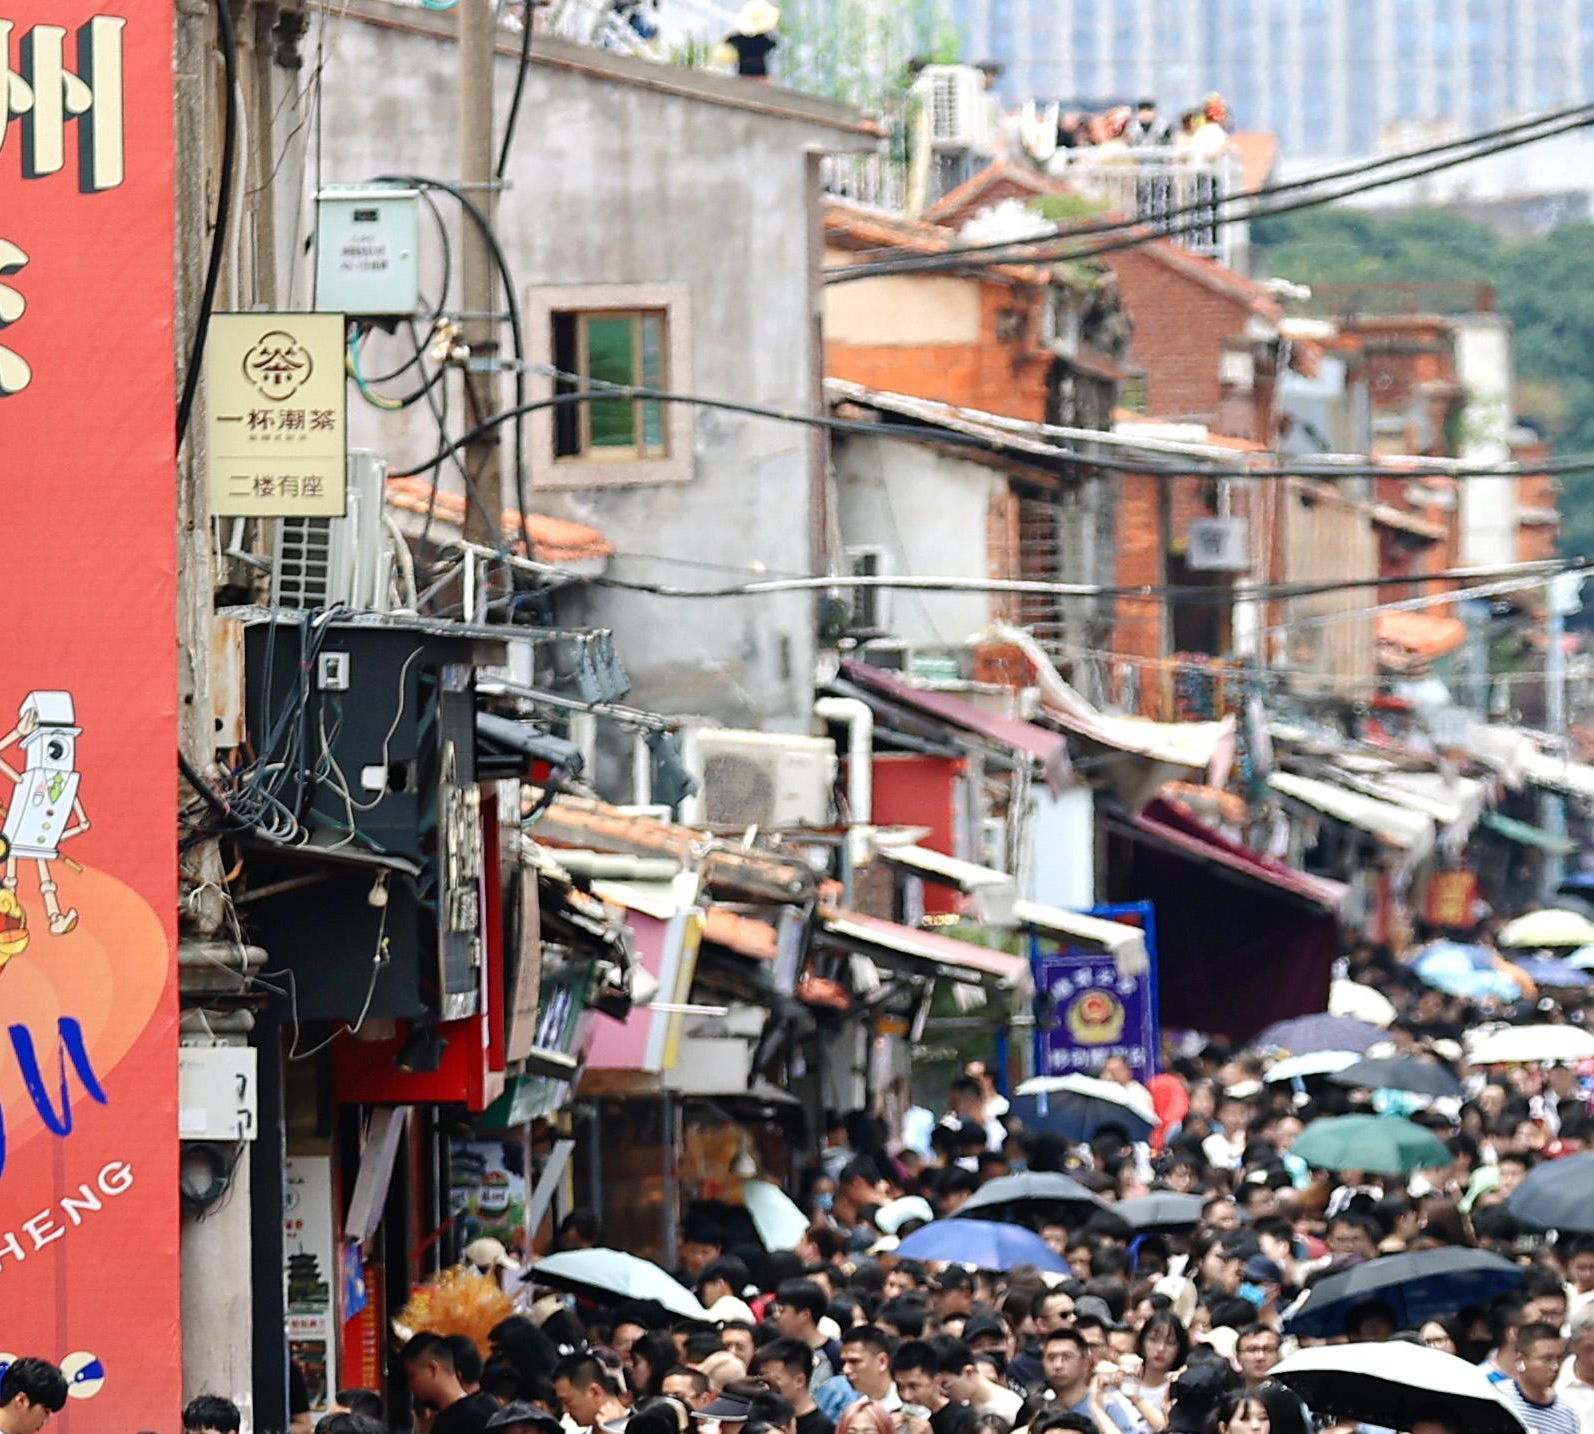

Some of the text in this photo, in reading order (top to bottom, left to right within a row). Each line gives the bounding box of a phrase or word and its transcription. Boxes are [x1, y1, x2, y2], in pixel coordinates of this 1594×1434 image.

[217, 408, 336, 431] 一杯潮茶
[228, 474, 325, 497] 二楼有座
